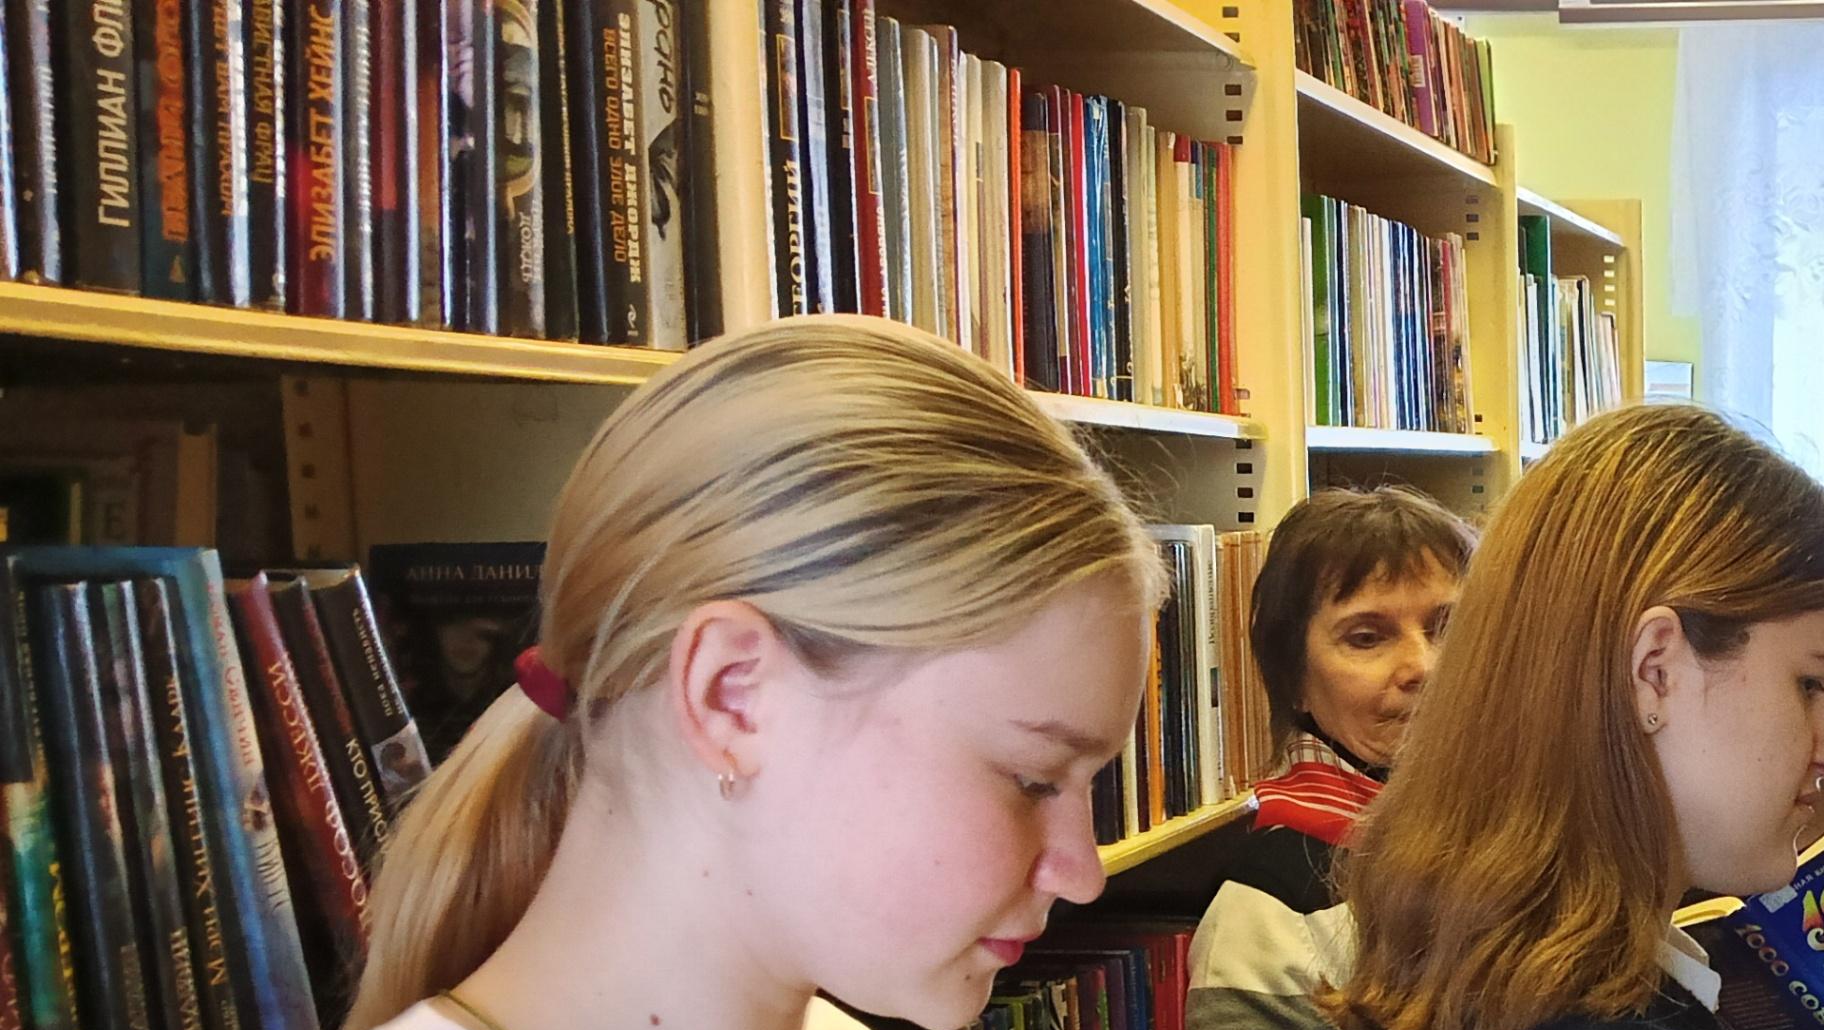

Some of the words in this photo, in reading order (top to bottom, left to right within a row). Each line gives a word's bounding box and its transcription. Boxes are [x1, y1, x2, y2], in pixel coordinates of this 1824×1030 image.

[305, 4, 335, 101] ХЕЙНС
[602, 28, 620, 90] ВСЕГО
[617, 13, 637, 155] ЭЛИЗАБЕТ
[96, 66, 131, 228] ГИЛЛИАН
[604, 96, 622, 150] ОДНО
[308, 107, 337, 263] ЭЛИЗАБЕТ
[608, 156, 625, 205] ЗЛОЕ
[518, 212, 536, 284] ДОЖДЬ
[609, 210, 628, 262] ДЕЛО
[624, 163, 642, 283] ДЖОРДЖ
[344, 737, 368, 781] КТО
[1735, 924, 1790, 977] 1000
